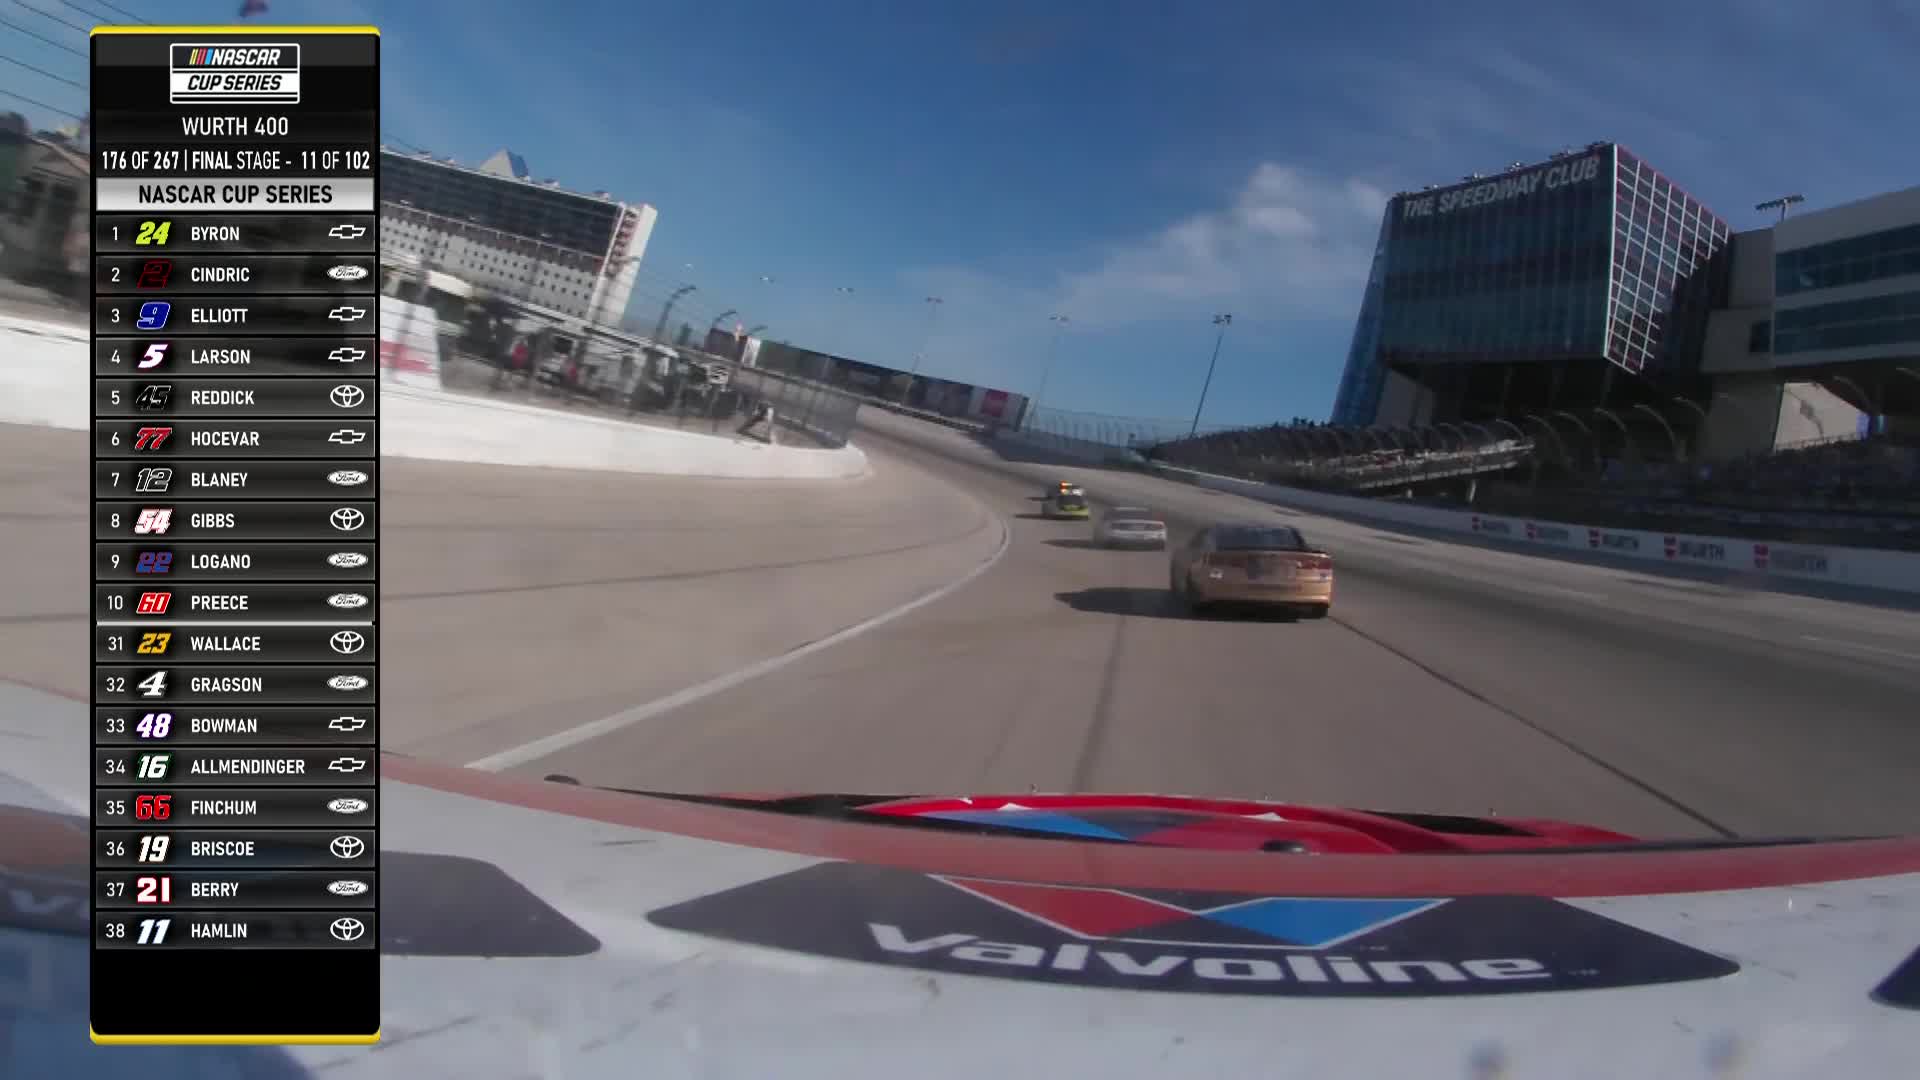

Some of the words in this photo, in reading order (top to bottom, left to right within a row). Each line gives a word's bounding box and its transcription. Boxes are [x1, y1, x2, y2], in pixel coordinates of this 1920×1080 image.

[1405, 197, 1434, 217] THE
[1439, 174, 1541, 212] SPEEDWAY
[1544, 159, 1600, 189] CLUB
[868, 921, 1553, 984] Valvoline
